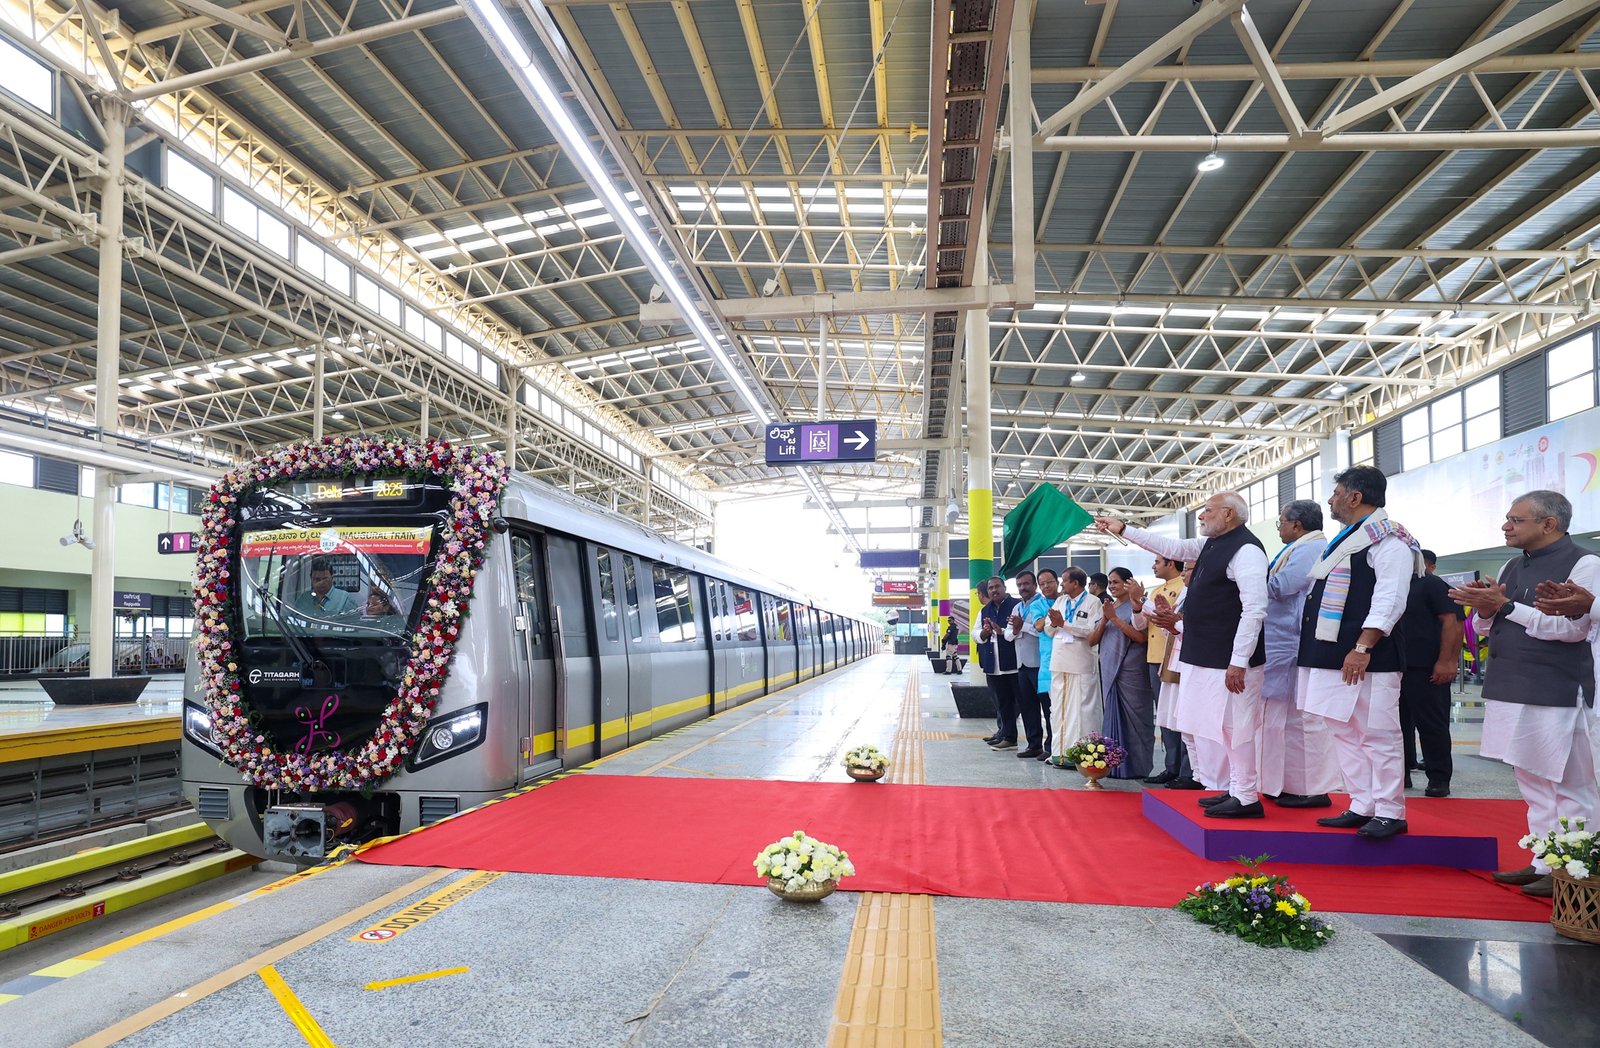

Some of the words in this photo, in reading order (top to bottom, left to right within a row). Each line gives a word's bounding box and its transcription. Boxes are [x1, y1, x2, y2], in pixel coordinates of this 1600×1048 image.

[779, 445, 796, 455] Lift
[377, 483, 403, 497] 2025
[339, 531, 387, 540] INAUGURAL
[390, 531, 416, 540] TRAIN
[380, 917, 420, 929] DO
[404, 902, 446, 917] NOT
[437, 888, 473, 903] CROSS
[38, 919, 63, 933] DANGER
[75, 910, 91, 920] VOLTS
